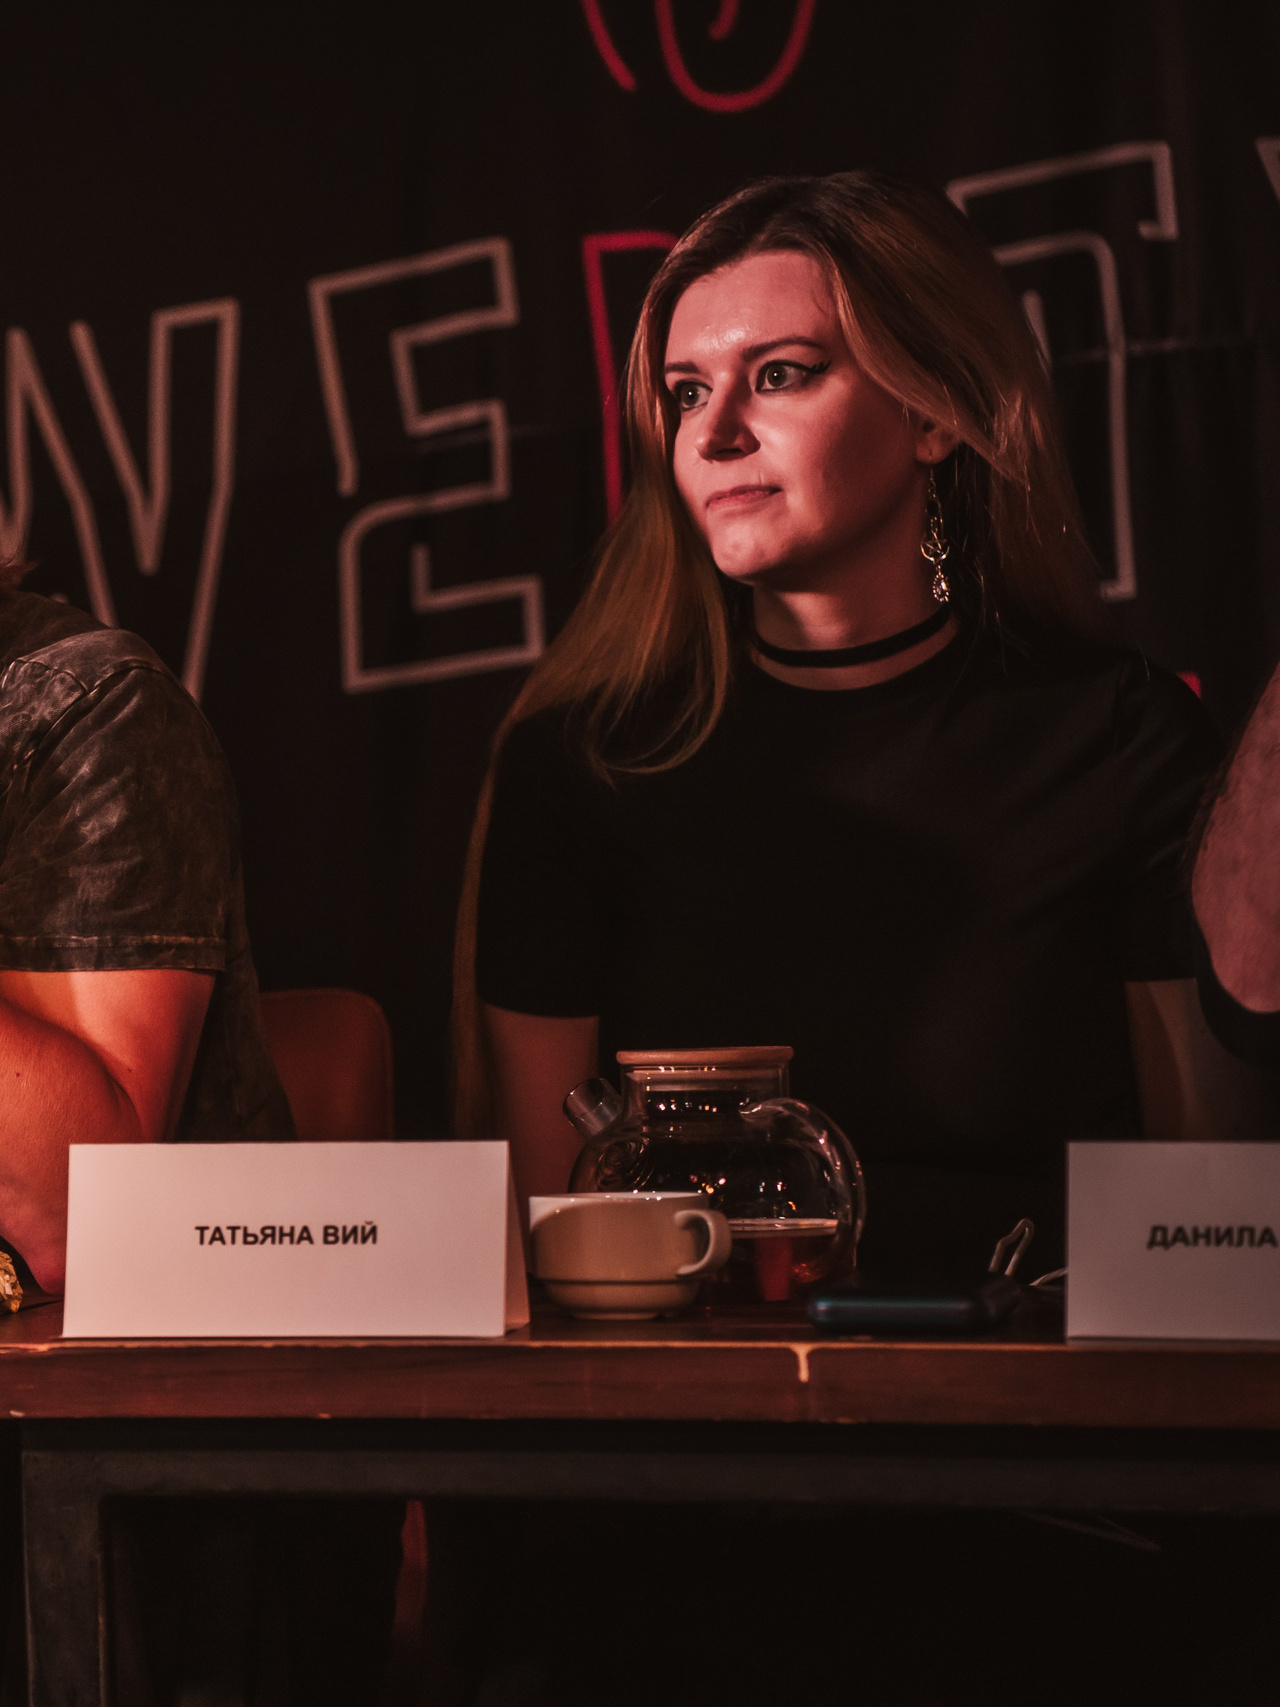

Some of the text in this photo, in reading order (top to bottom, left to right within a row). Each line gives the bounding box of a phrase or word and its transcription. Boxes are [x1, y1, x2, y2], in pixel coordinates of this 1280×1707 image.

[194, 1220, 378, 1246] ТАТЬЯНА ВИЙ
[1146, 1224, 1279, 1251] ДАНИЛА
